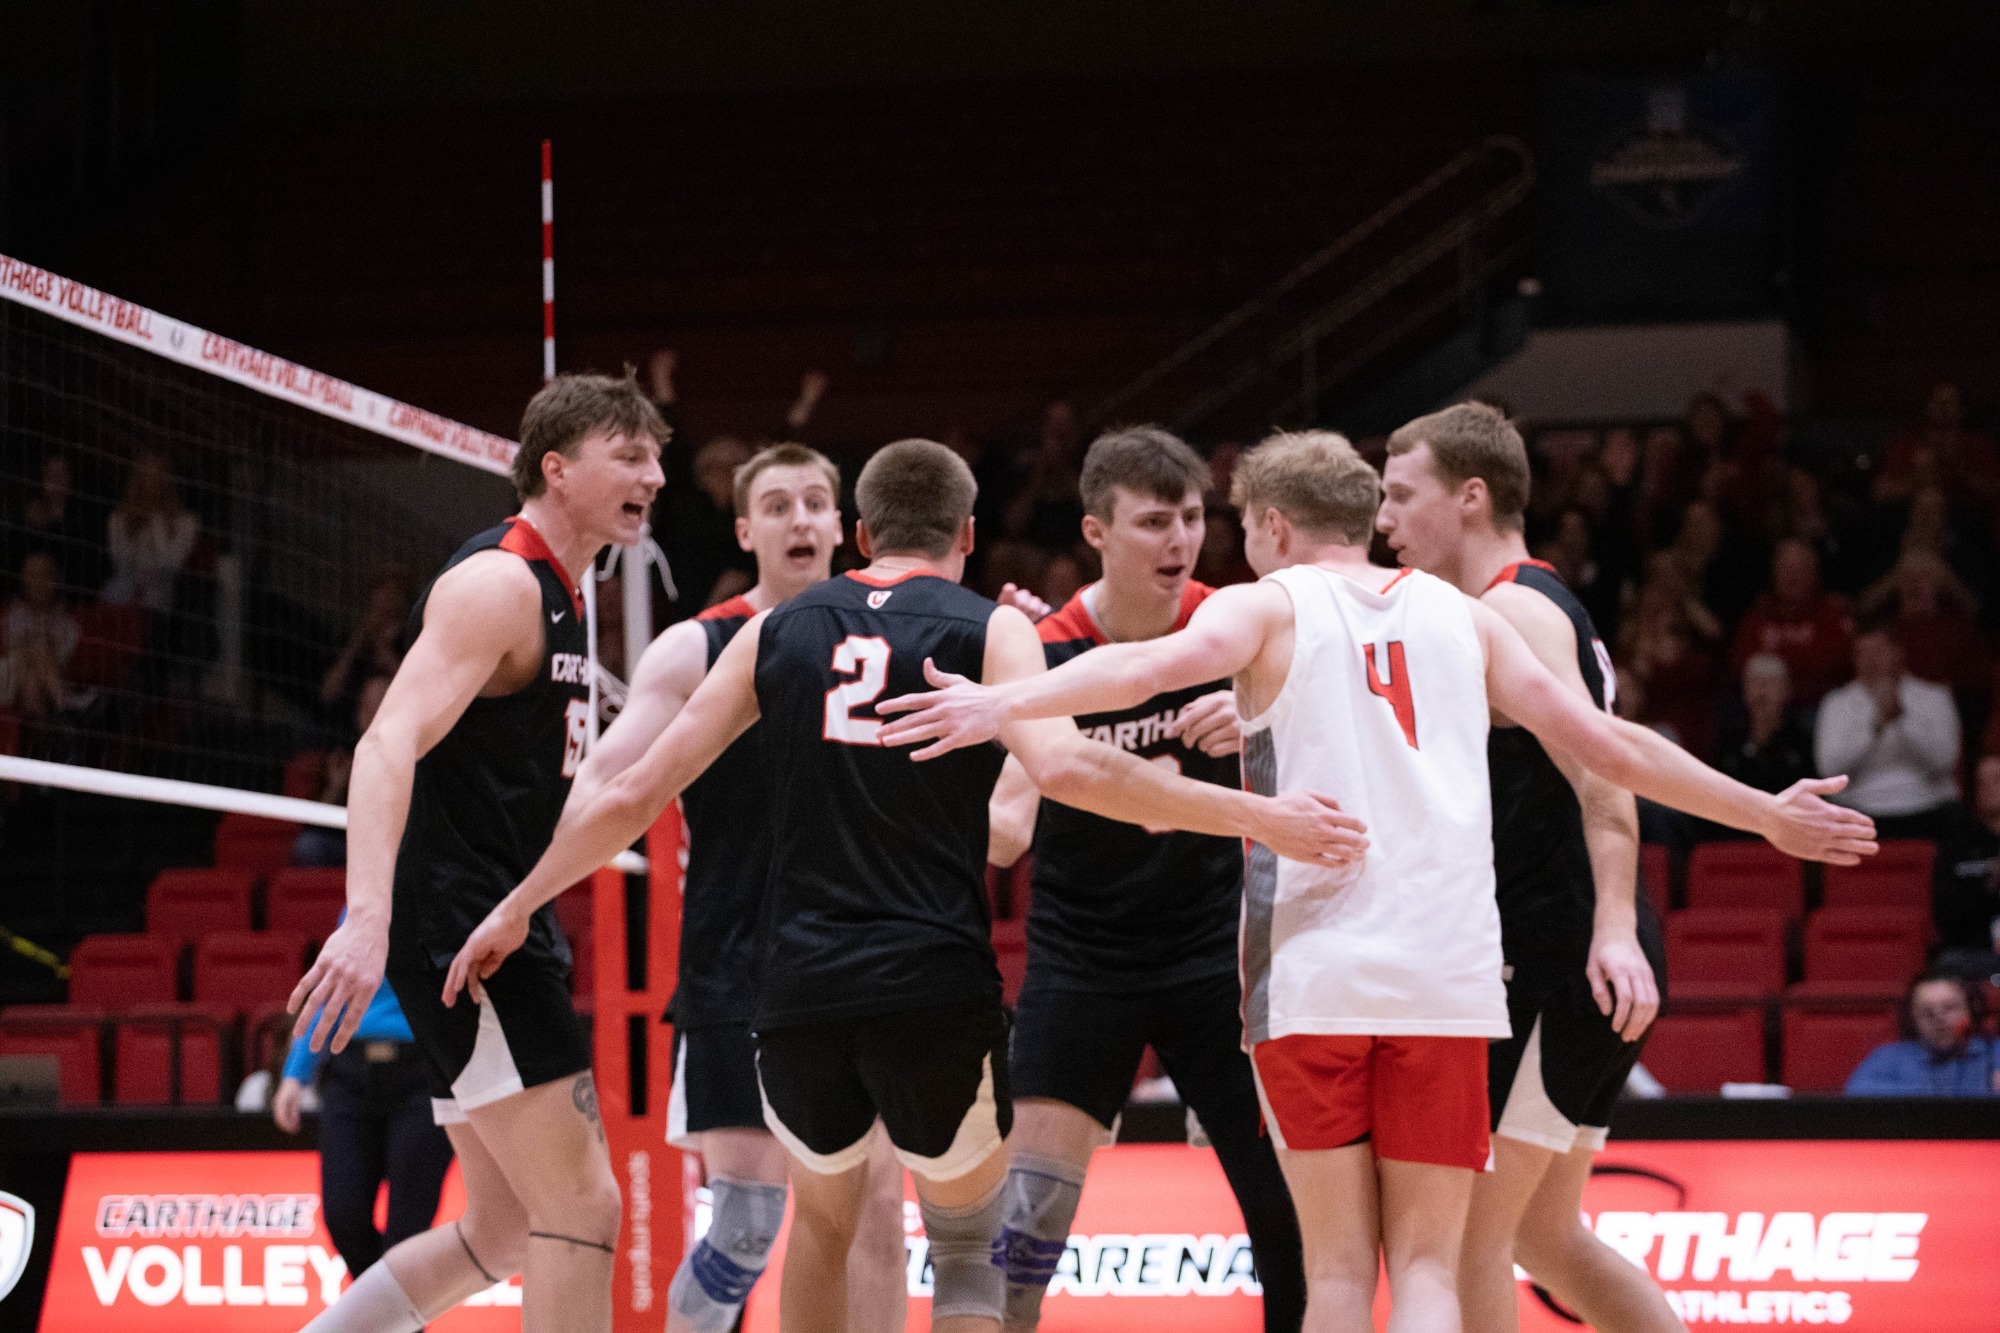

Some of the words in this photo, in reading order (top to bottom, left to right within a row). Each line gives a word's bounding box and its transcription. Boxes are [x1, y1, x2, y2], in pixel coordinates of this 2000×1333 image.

[822, 634, 892, 747] 2
[1363, 641, 1420, 750] 4
[1080, 709, 1176, 750] ARTH
[97, 1194, 321, 1238] CARTHAGE
[1578, 1211, 1928, 1281] RTHAGE
[1048, 1235, 1263, 1296] ARENA
